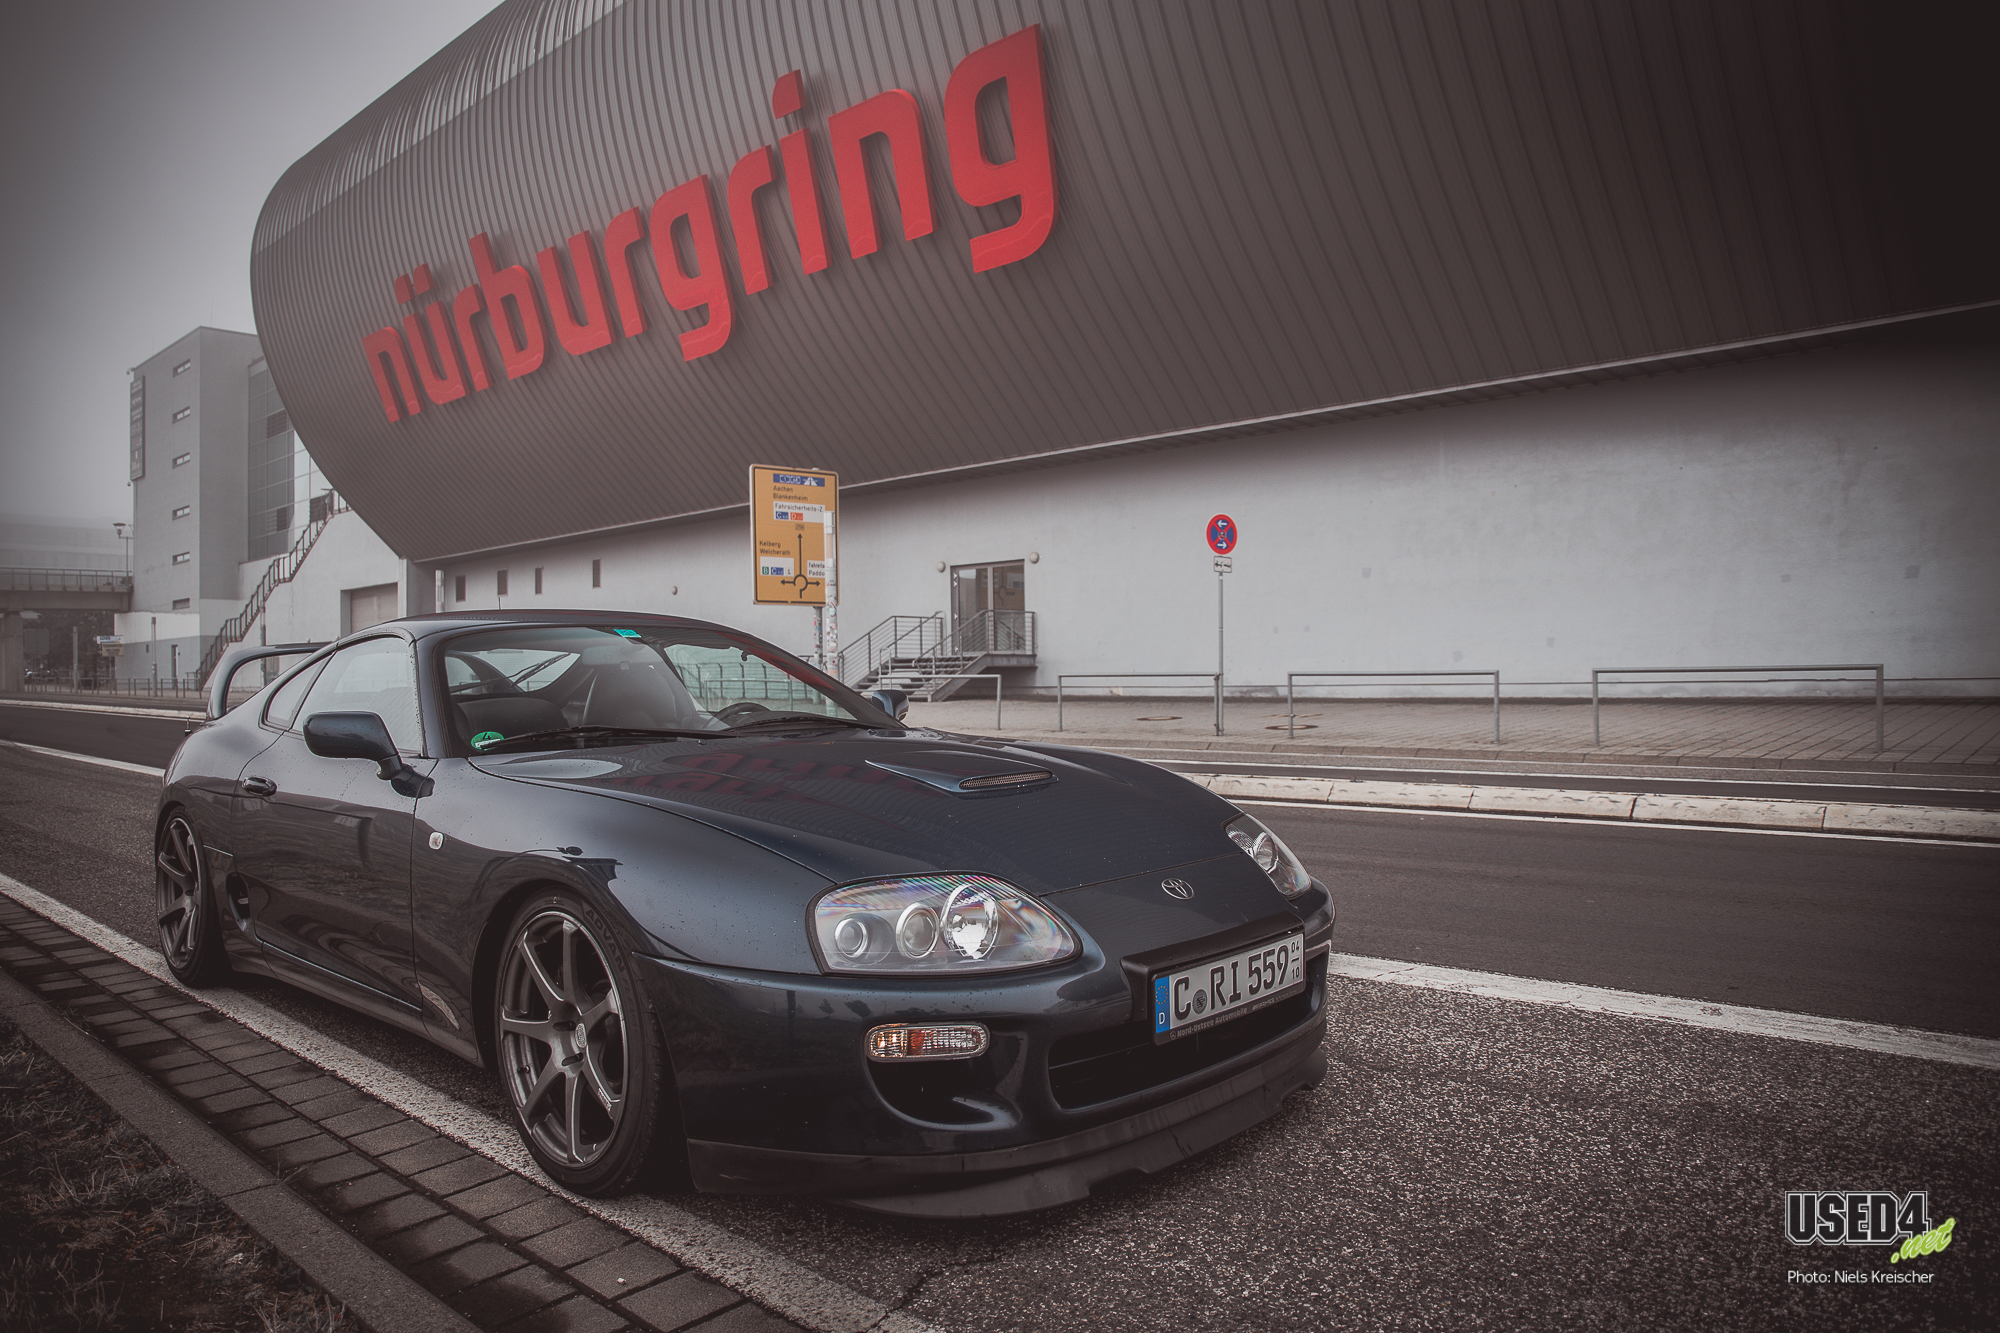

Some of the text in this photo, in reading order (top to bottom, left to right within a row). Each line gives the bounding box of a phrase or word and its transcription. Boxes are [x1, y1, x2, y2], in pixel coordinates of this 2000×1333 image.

[361, 22, 1059, 424] nürburgring
[773, 493, 808, 501] Blankenheim
[585, 909, 626, 974] ADVAN
[1173, 945, 1289, 1020] C RI 559
[1291, 967, 1300, 980] 10
[1158, 1012, 1165, 1025] D
[1215, 1006, 1248, 1024] Automobile
